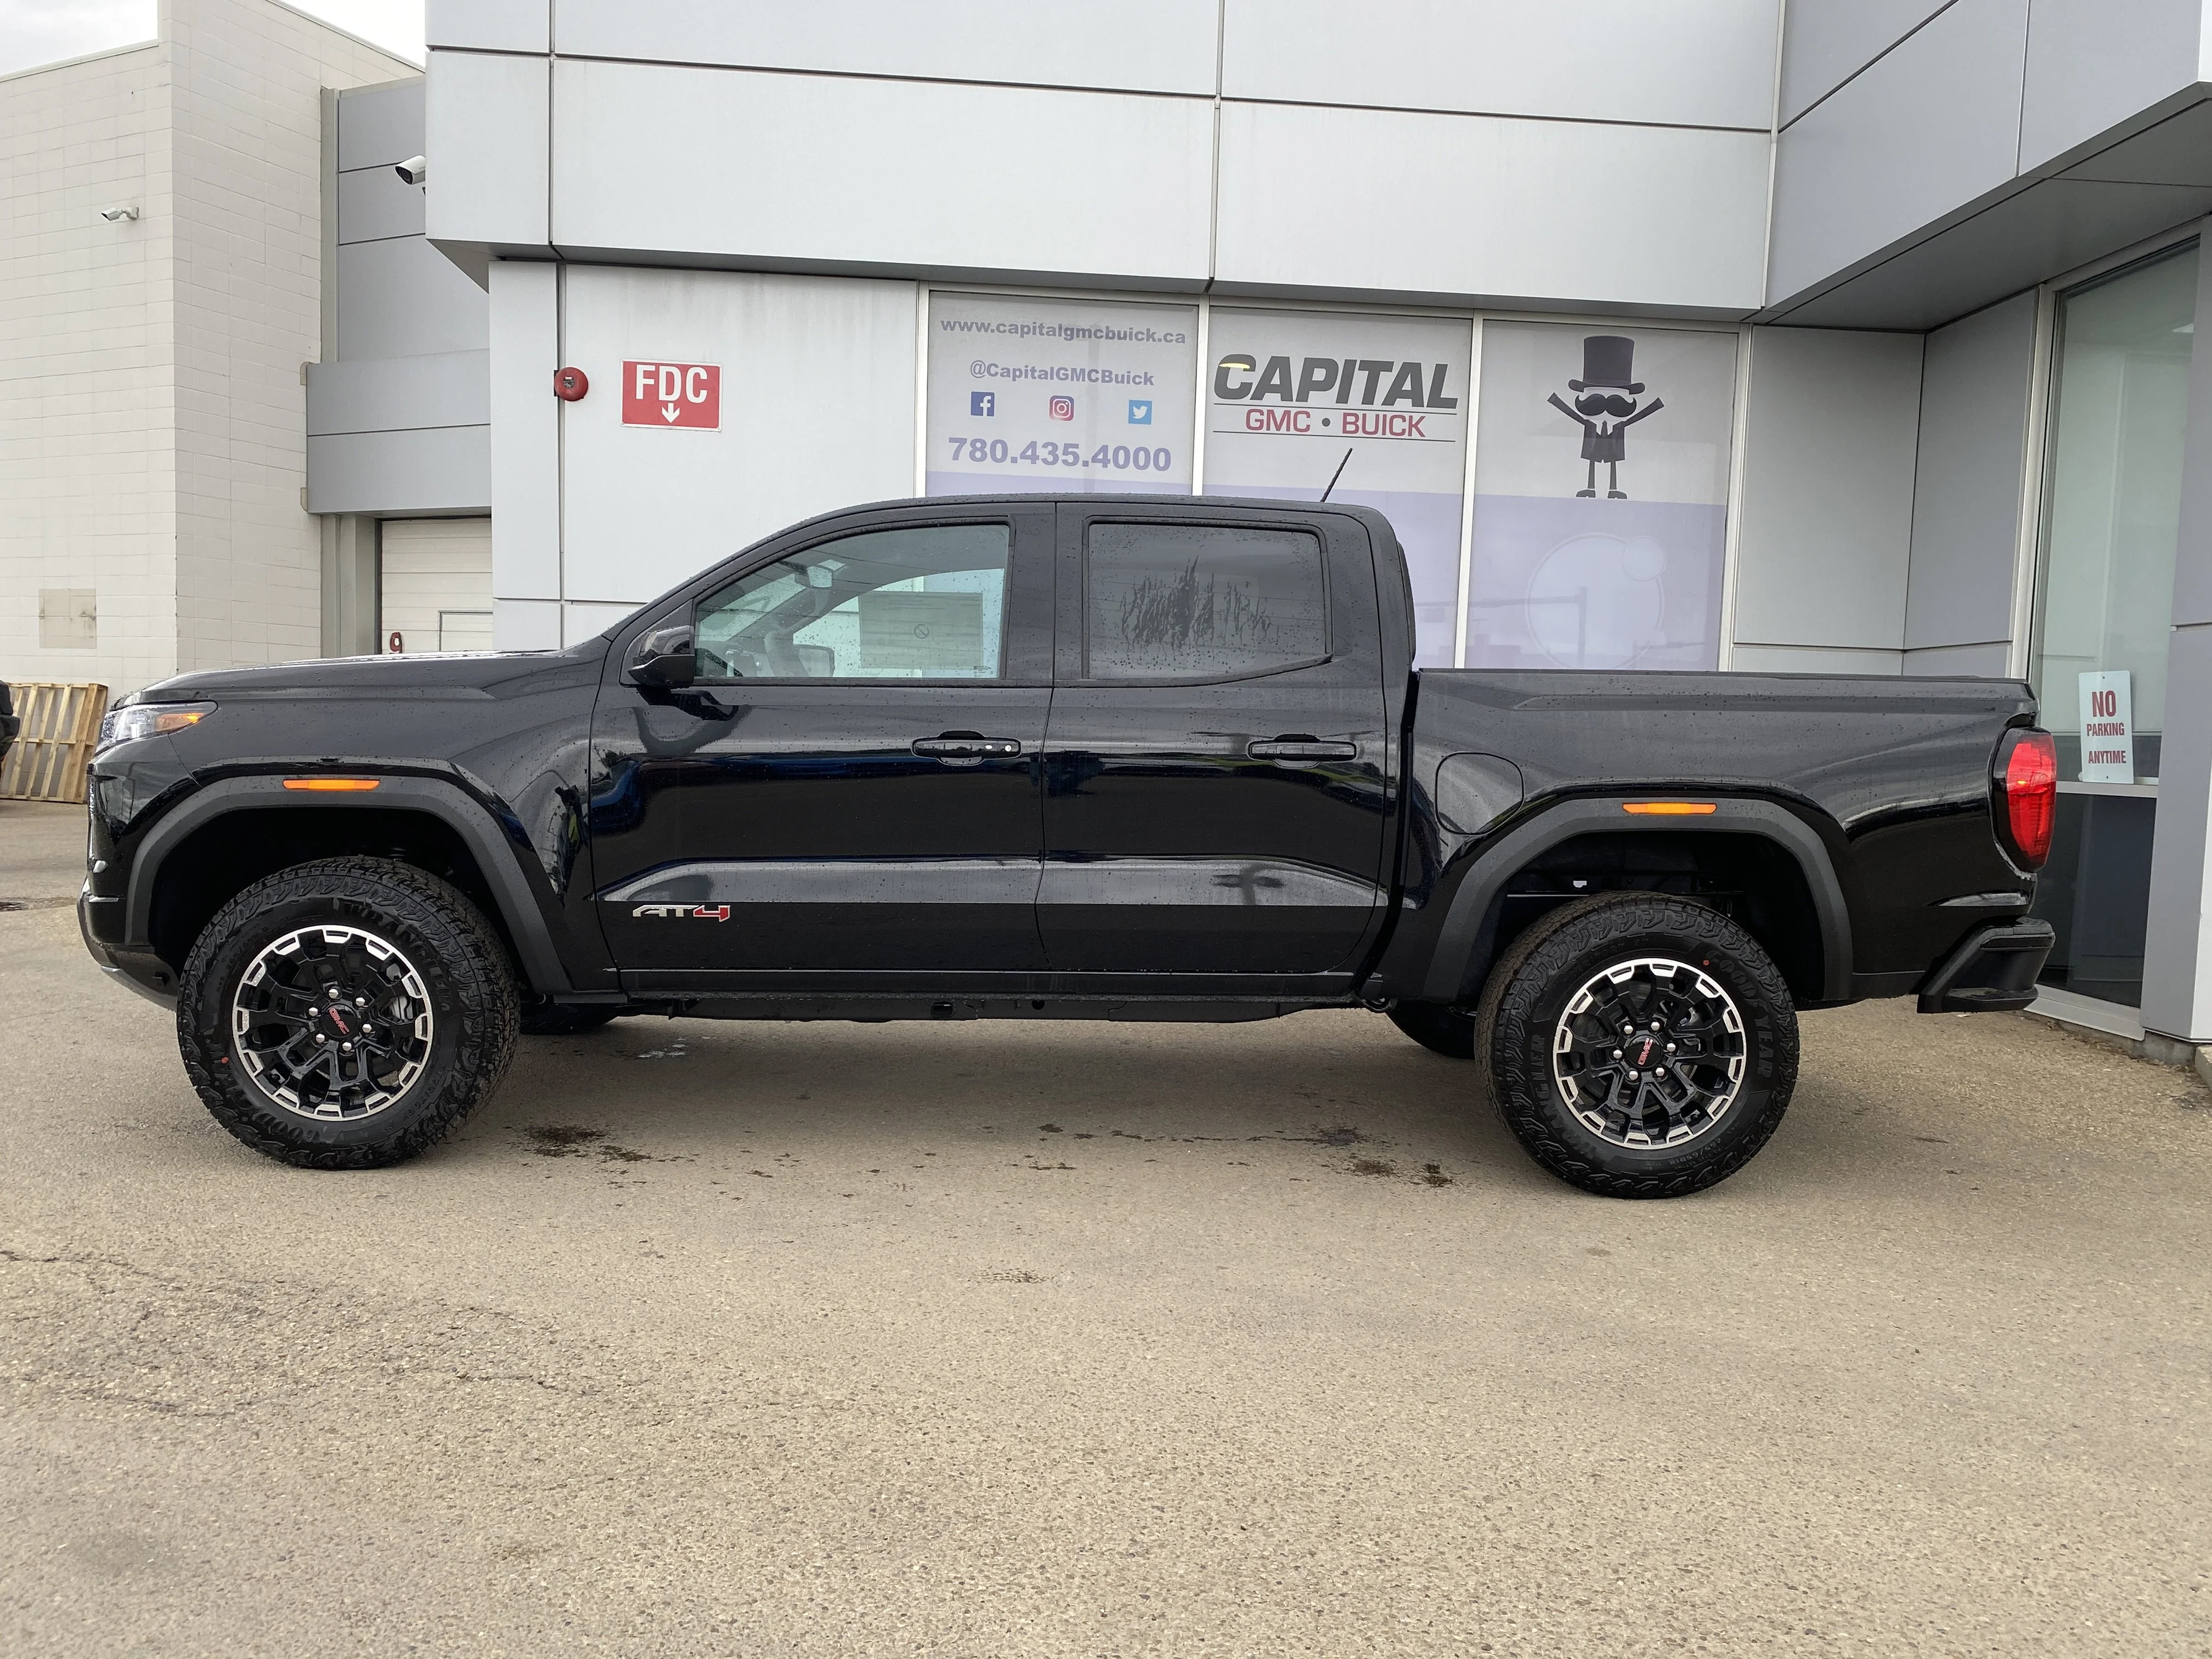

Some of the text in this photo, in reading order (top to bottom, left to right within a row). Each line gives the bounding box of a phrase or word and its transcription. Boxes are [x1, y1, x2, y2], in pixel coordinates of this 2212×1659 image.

[940, 319, 1186, 345] www.capitalgmcbuick.ca
[635, 364, 708, 404] FDC
[969, 359, 1155, 386] @CapitalGMCBuick
[1214, 353, 1459, 409] CAPITAL
[1245, 408, 1426, 438] GMC BUICK
[948, 437, 1172, 472] 780.435.4000
[2091, 690, 2117, 718] NO
[2086, 722, 2125, 737] PARKING
[2088, 750, 2127, 764] ANYTIME
[632, 904, 731, 923] AT4
[329, 1007, 350, 1035] GMC
[1704, 950, 1774, 1079] GOODYEAR
[1637, 1037, 1654, 1065] GMC
